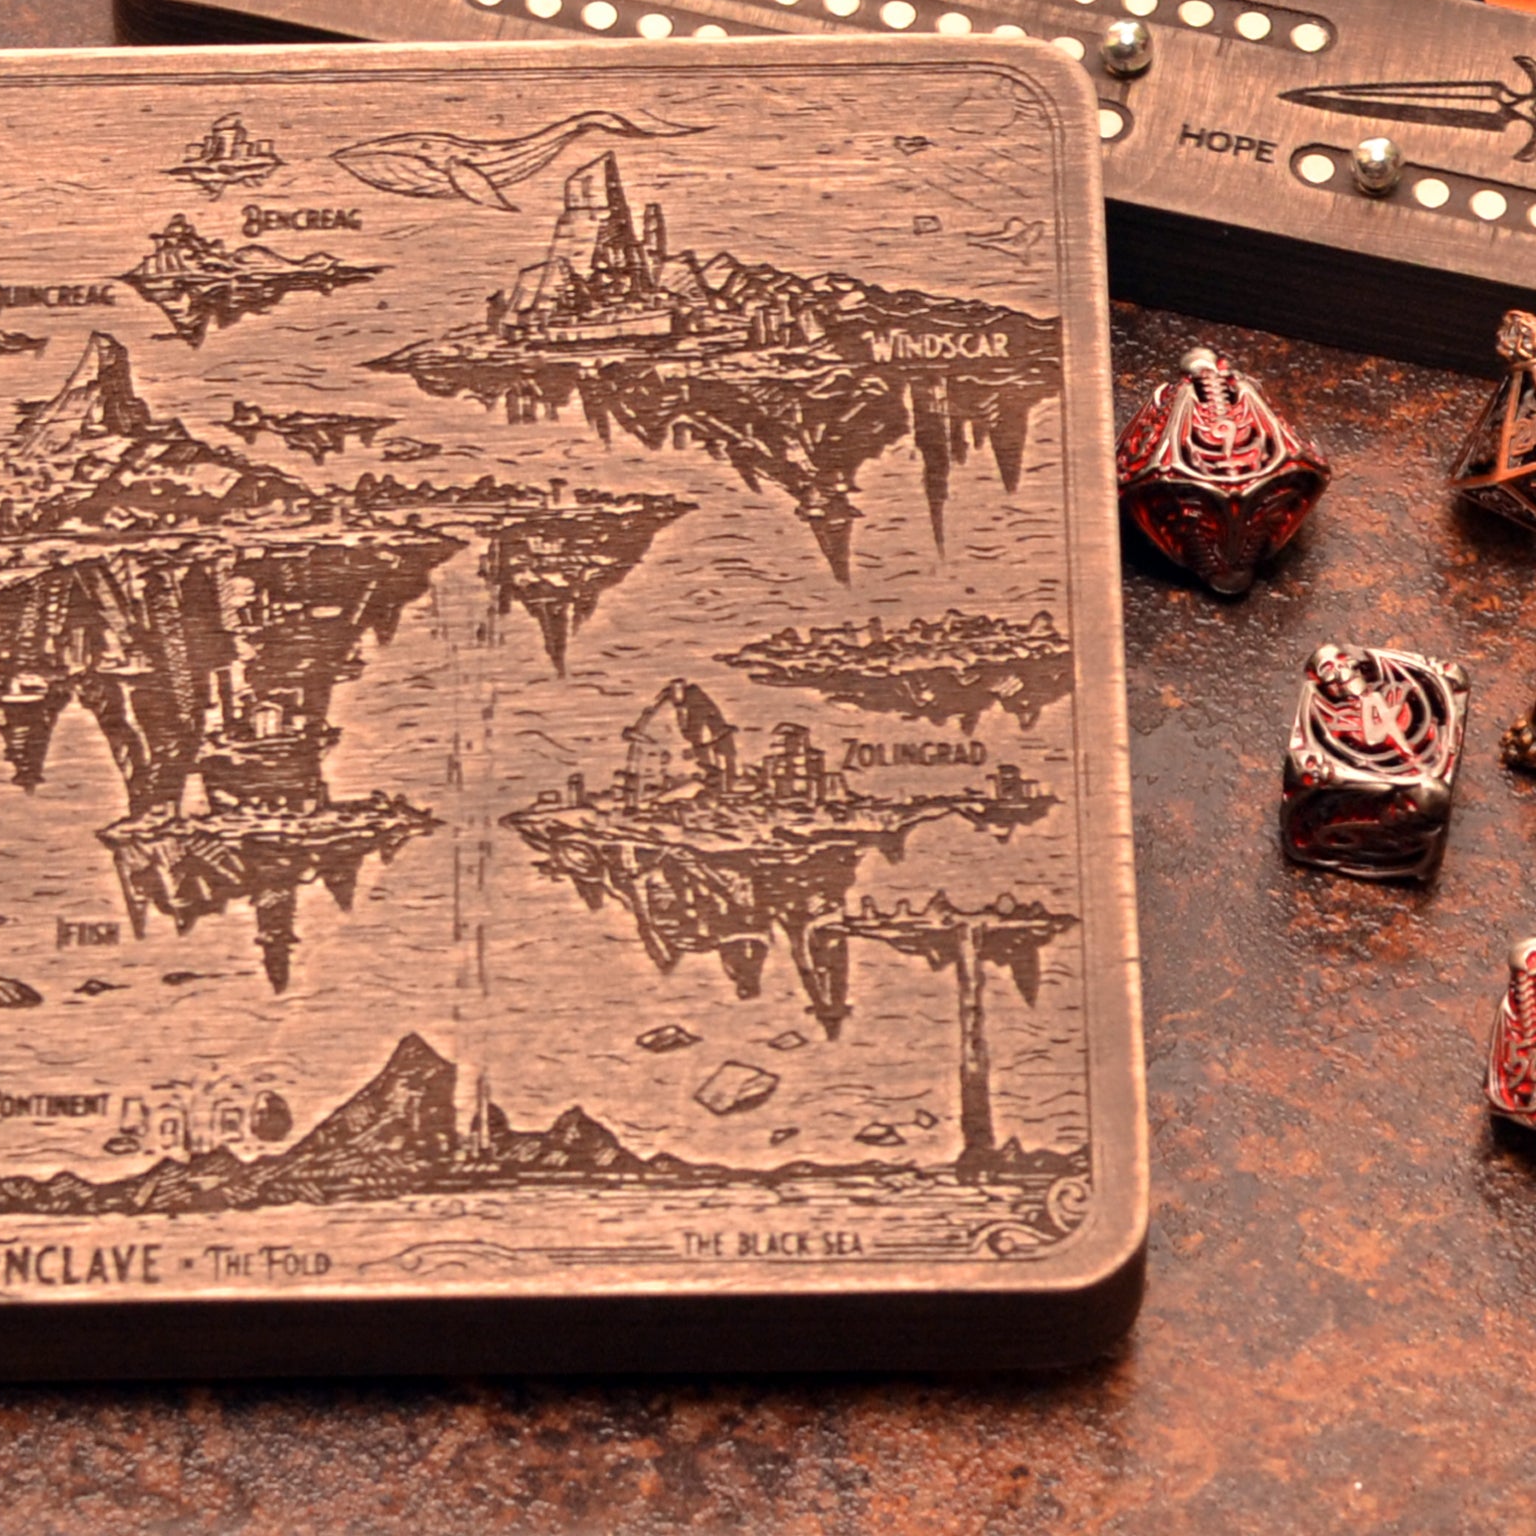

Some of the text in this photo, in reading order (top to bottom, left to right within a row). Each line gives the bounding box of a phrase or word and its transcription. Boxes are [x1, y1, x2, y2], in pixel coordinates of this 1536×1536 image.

[1178, 124, 1277, 163] HOPE
[865, 330, 1010, 363] WINDSCAR
[840, 736, 990, 771] ZOLINGRAD
[682, 1230, 864, 1257] THE BLACK SEA
[203, 1244, 257, 1280] THE
[260, 1244, 332, 1278] FOLD
